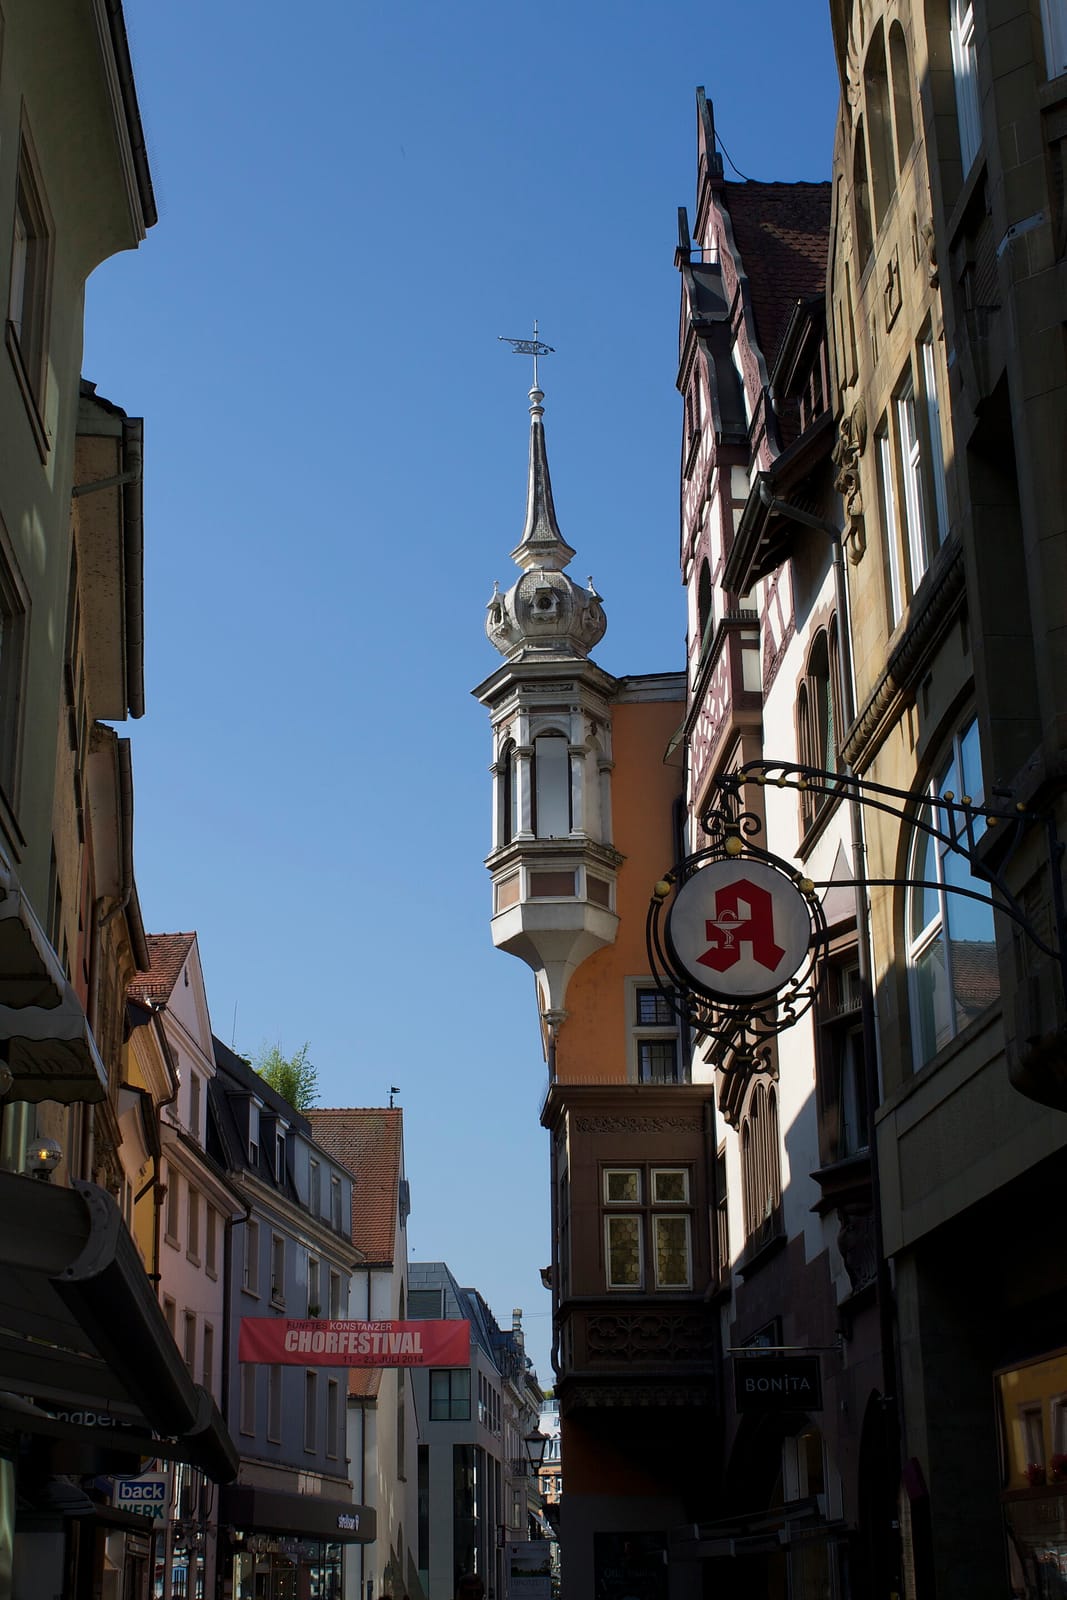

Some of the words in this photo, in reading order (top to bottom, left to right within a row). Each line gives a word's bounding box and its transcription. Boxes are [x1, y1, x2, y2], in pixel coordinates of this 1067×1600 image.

[696, 878, 786, 973] A
[329, 1321, 393, 1331] KONSTANZER
[284, 1330, 424, 1355] CHORFESTIVAL
[378, 1355, 400, 1364] JULI
[402, 1355, 424, 1364] 2014
[745, 1374, 811, 1394] BONITA
[121, 1482, 163, 1499] back
